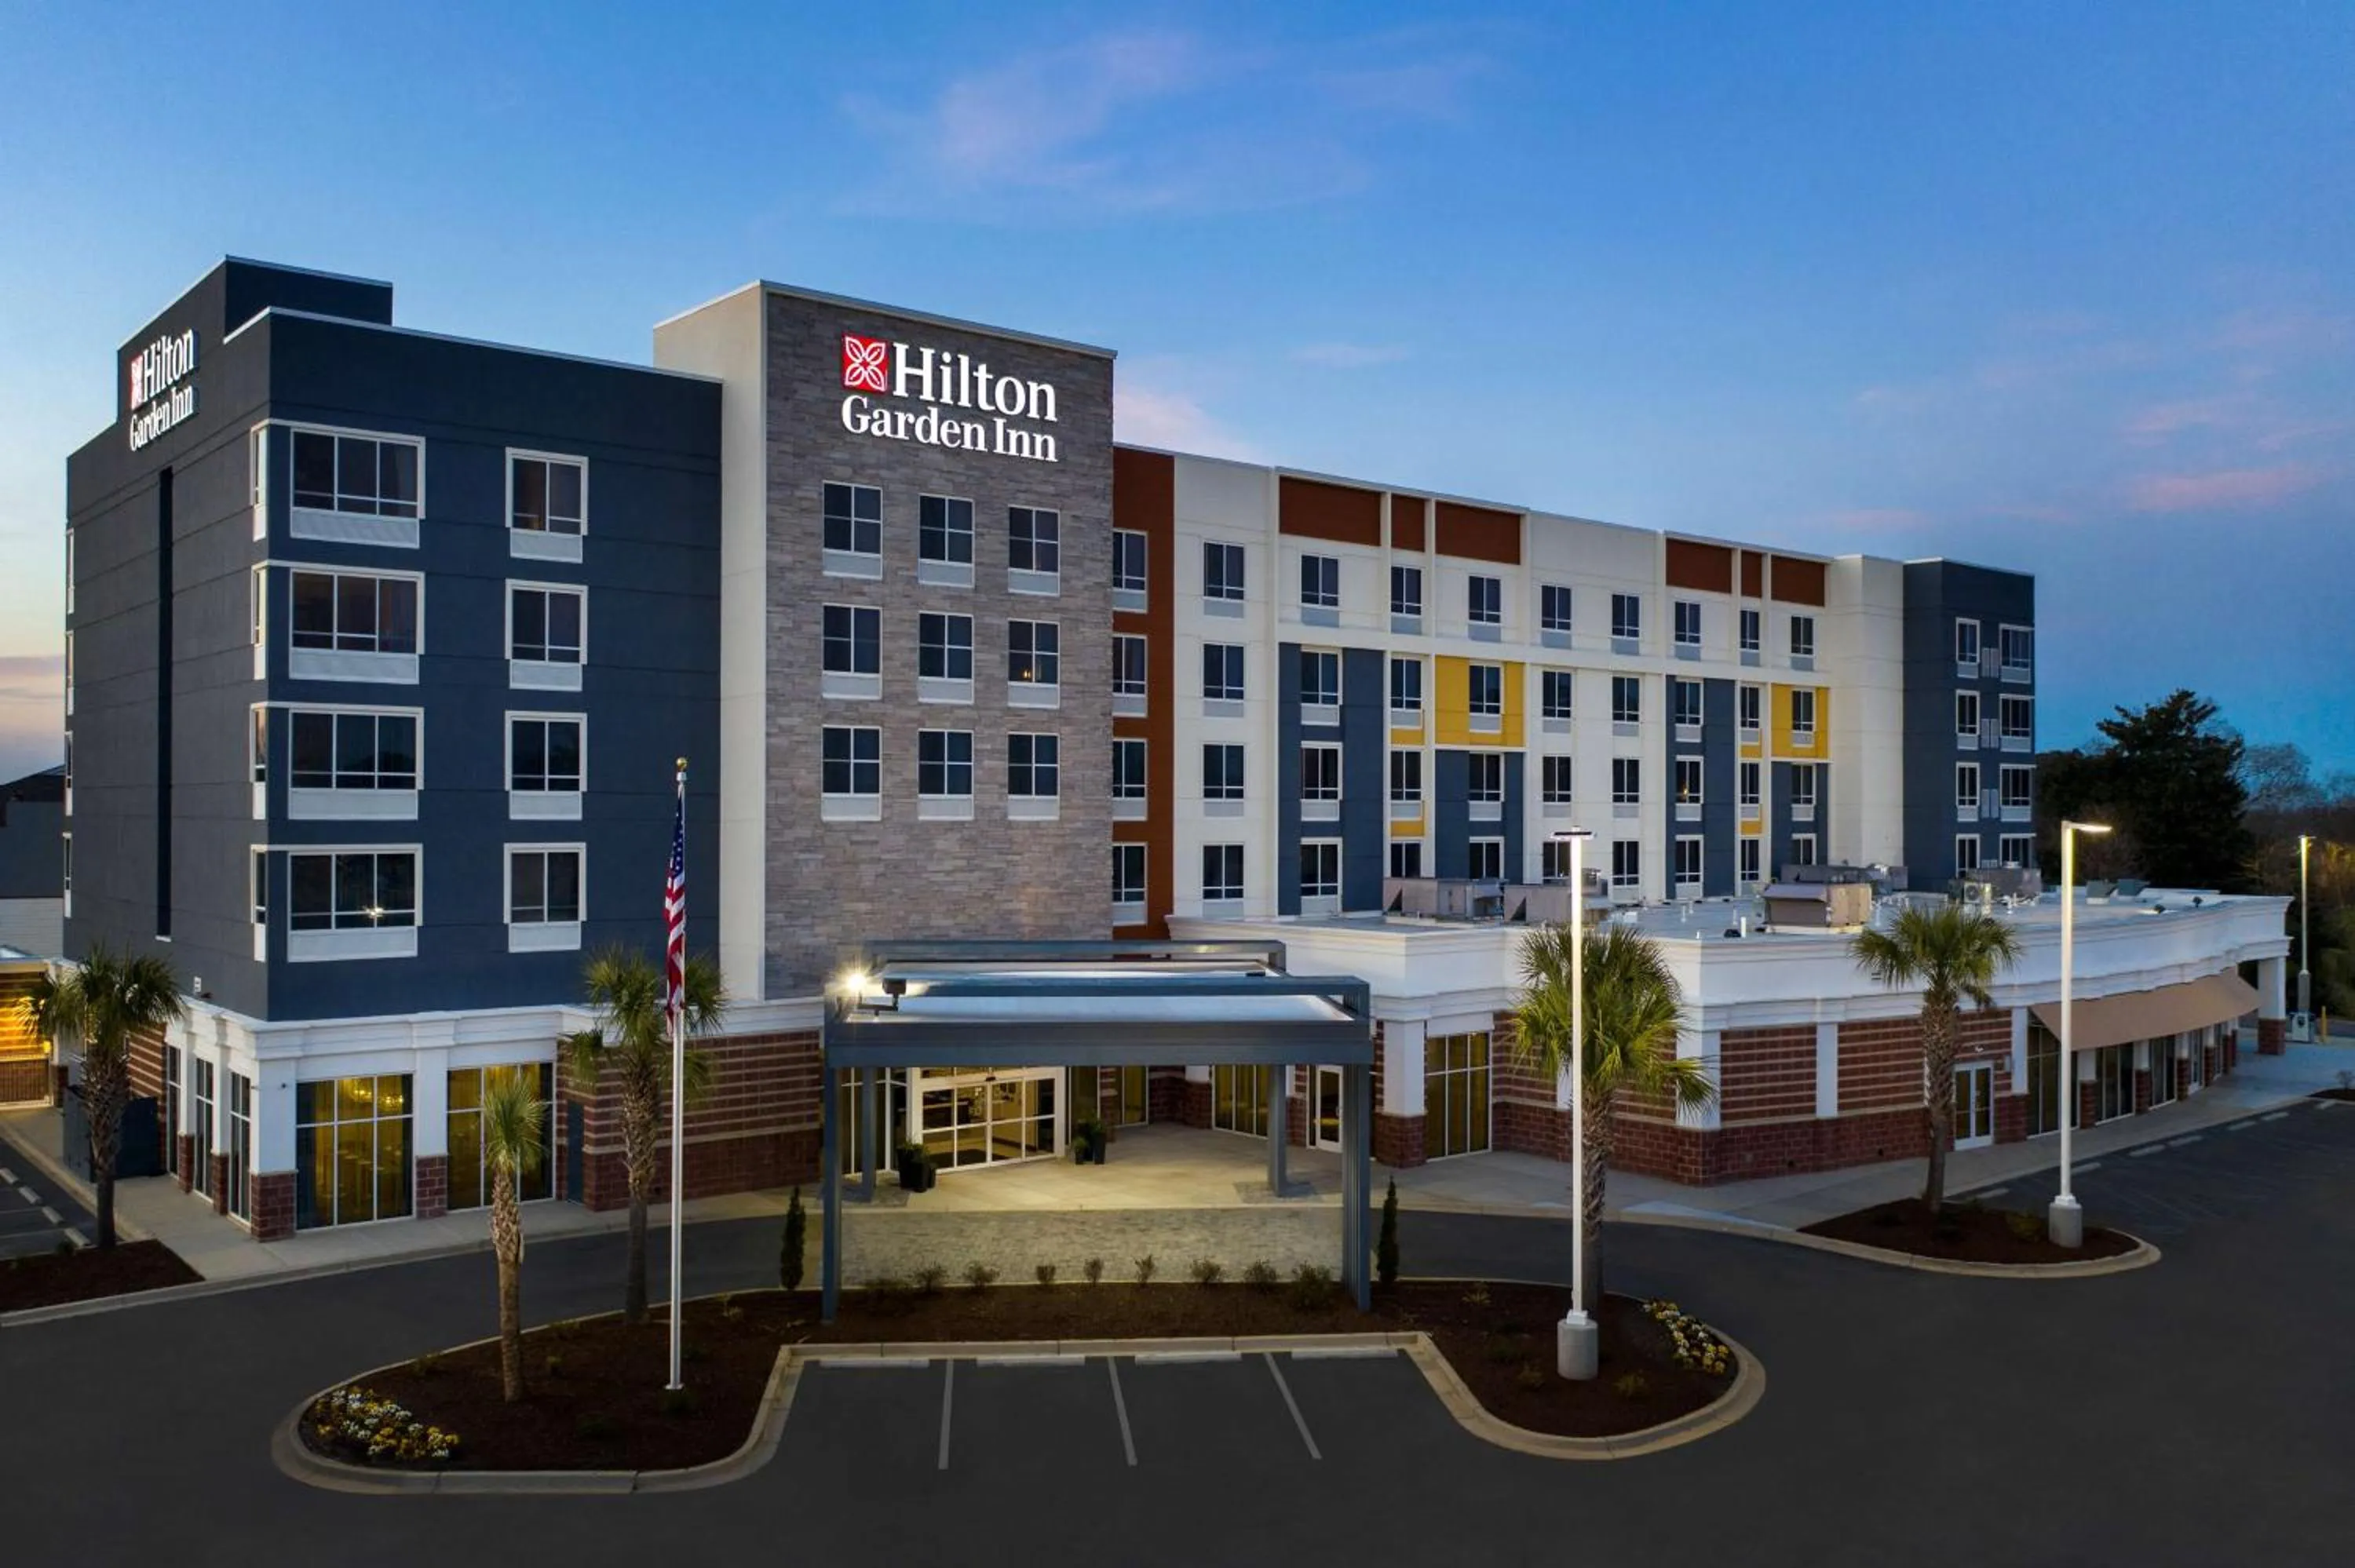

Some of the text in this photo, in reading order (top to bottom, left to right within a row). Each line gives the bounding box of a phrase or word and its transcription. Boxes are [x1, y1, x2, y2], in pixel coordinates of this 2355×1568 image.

[142, 329, 195, 403] Hilton
[893, 341, 1057, 421] Hilton
[130, 385, 194, 451] Garden Inn
[842, 395, 1058, 462] Garden Inn
